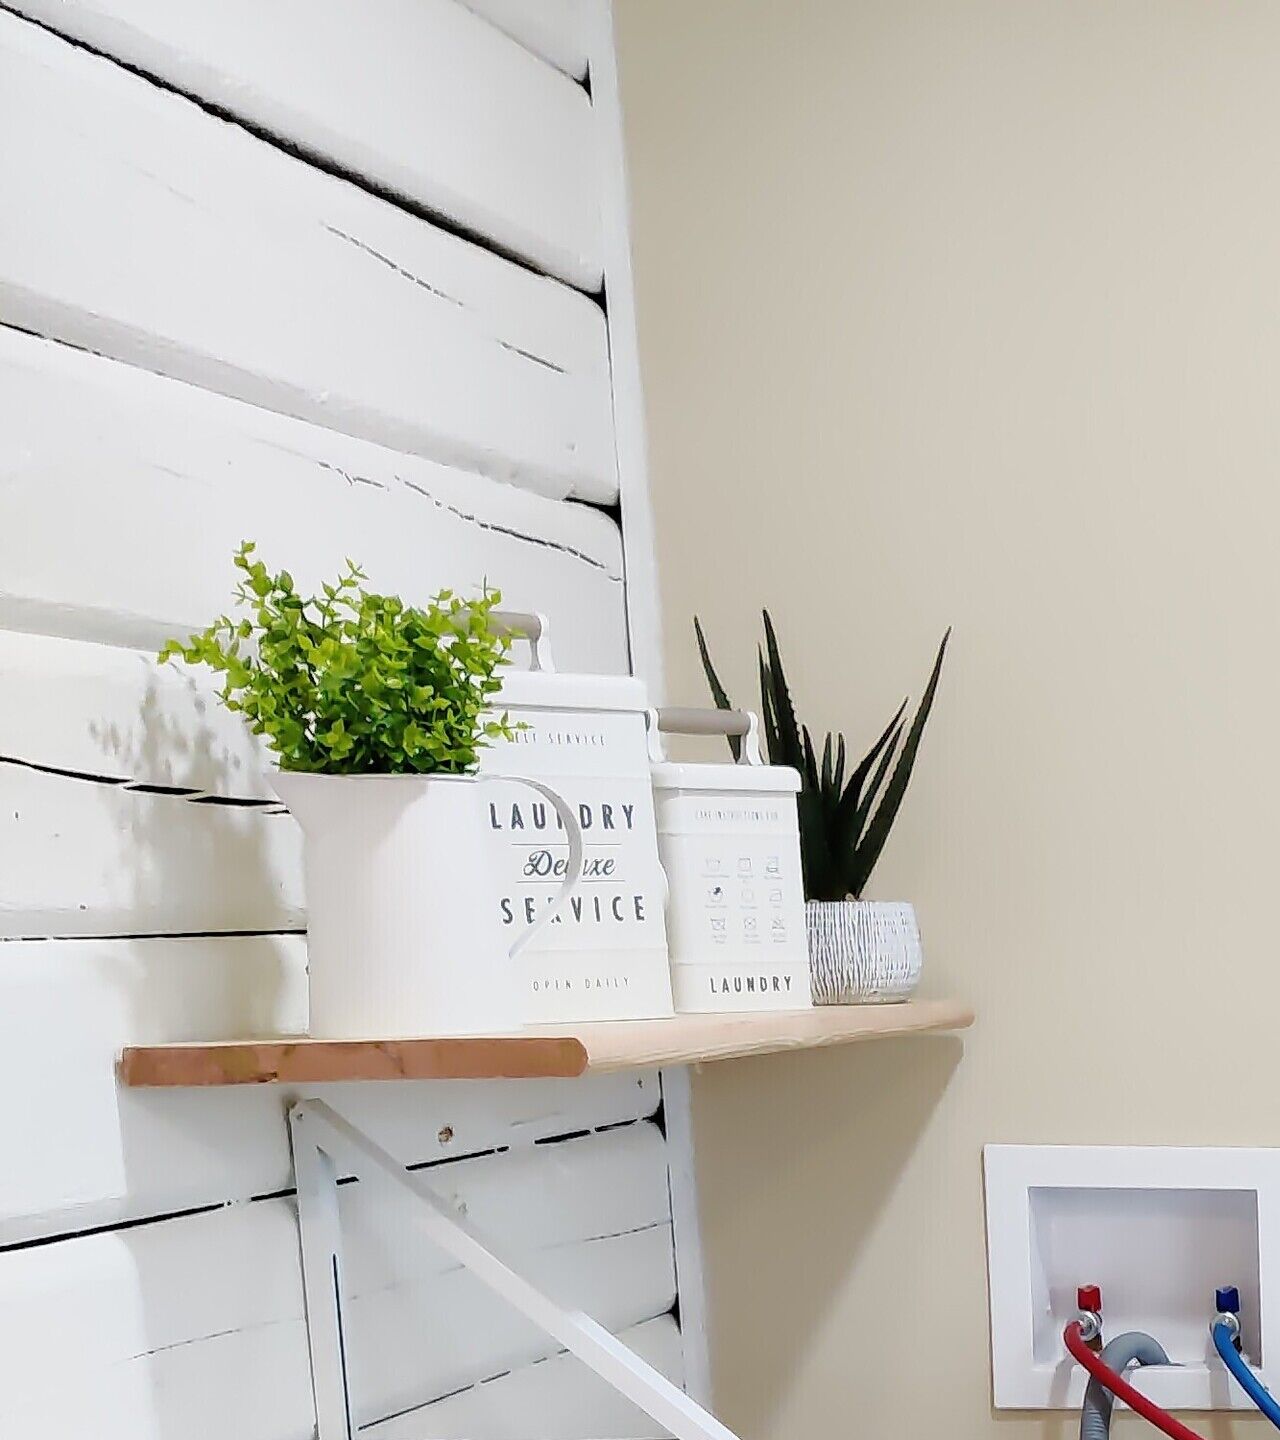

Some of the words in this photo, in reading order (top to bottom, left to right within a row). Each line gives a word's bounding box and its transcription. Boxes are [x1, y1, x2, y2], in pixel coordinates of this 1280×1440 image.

[533, 979, 571, 991] OPEN
[585, 977, 630, 989] DAILY
[710, 976, 792, 993] LAUNDRY
